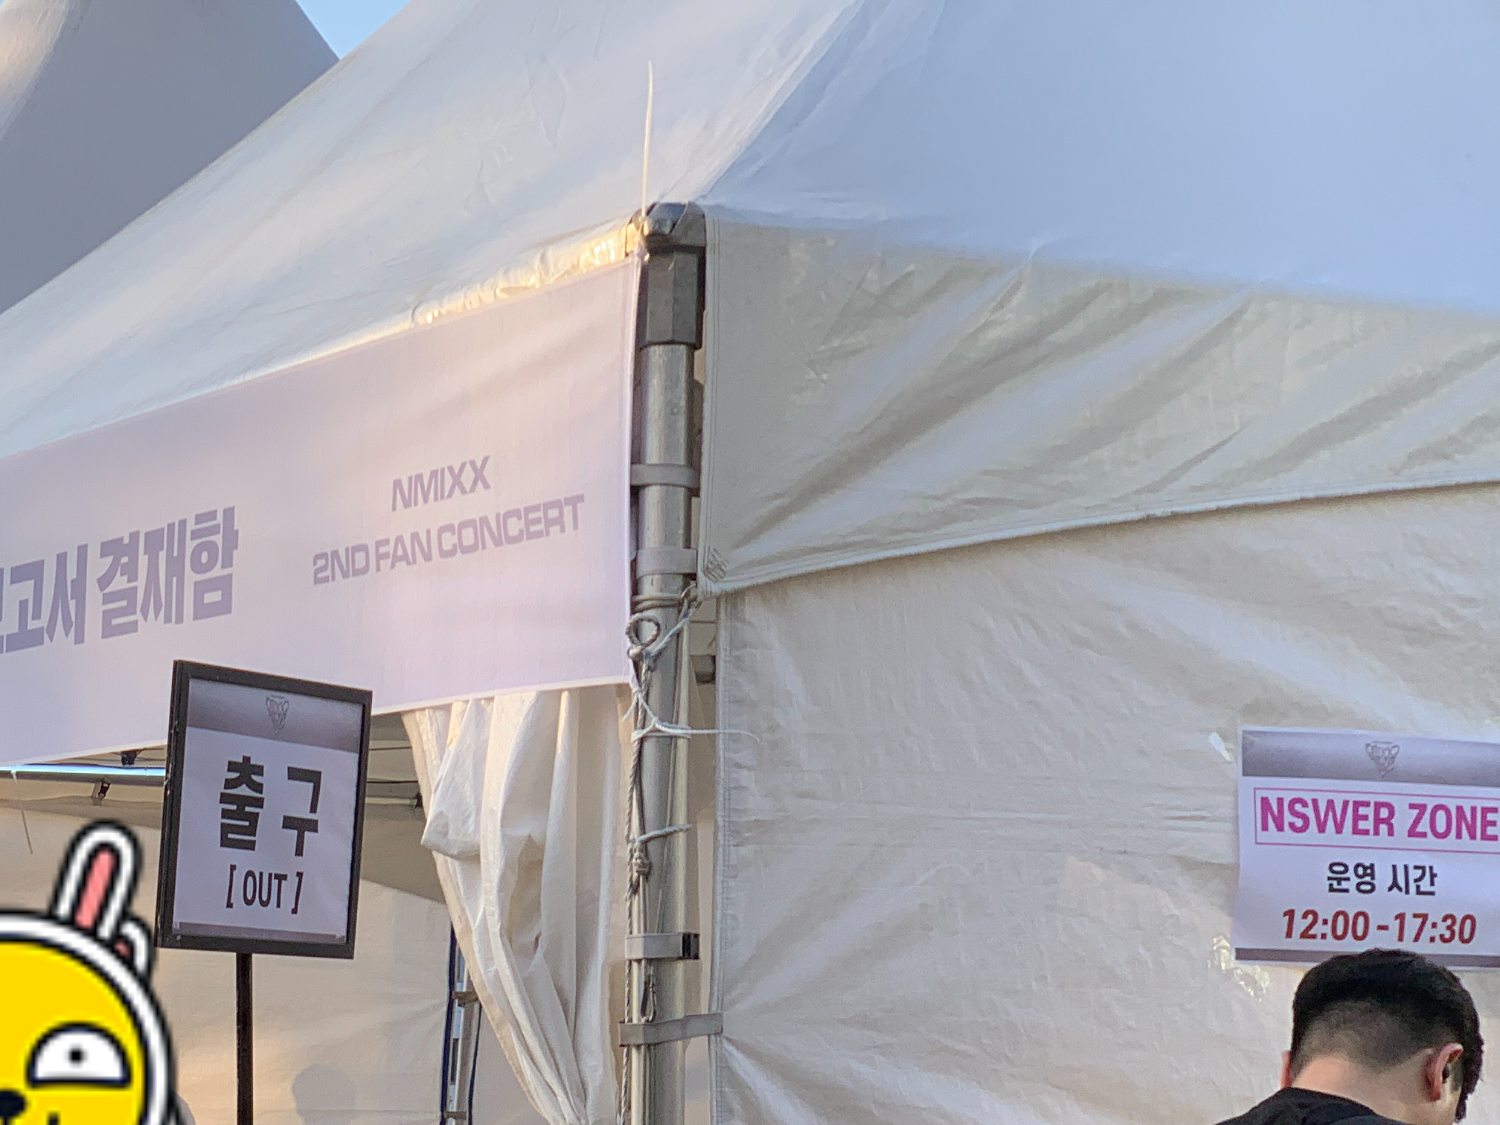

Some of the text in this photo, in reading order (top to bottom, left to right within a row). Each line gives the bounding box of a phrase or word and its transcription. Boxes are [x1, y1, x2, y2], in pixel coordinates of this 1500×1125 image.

[392, 455, 491, 512] NMIXX
[312, 493, 585, 585] 2ND FAN CONCERT
[96, 506, 239, 639] 결재함
[1260, 796, 1500, 842] NSWER ZONE
[1326, 861, 1438, 896] 운영 시간
